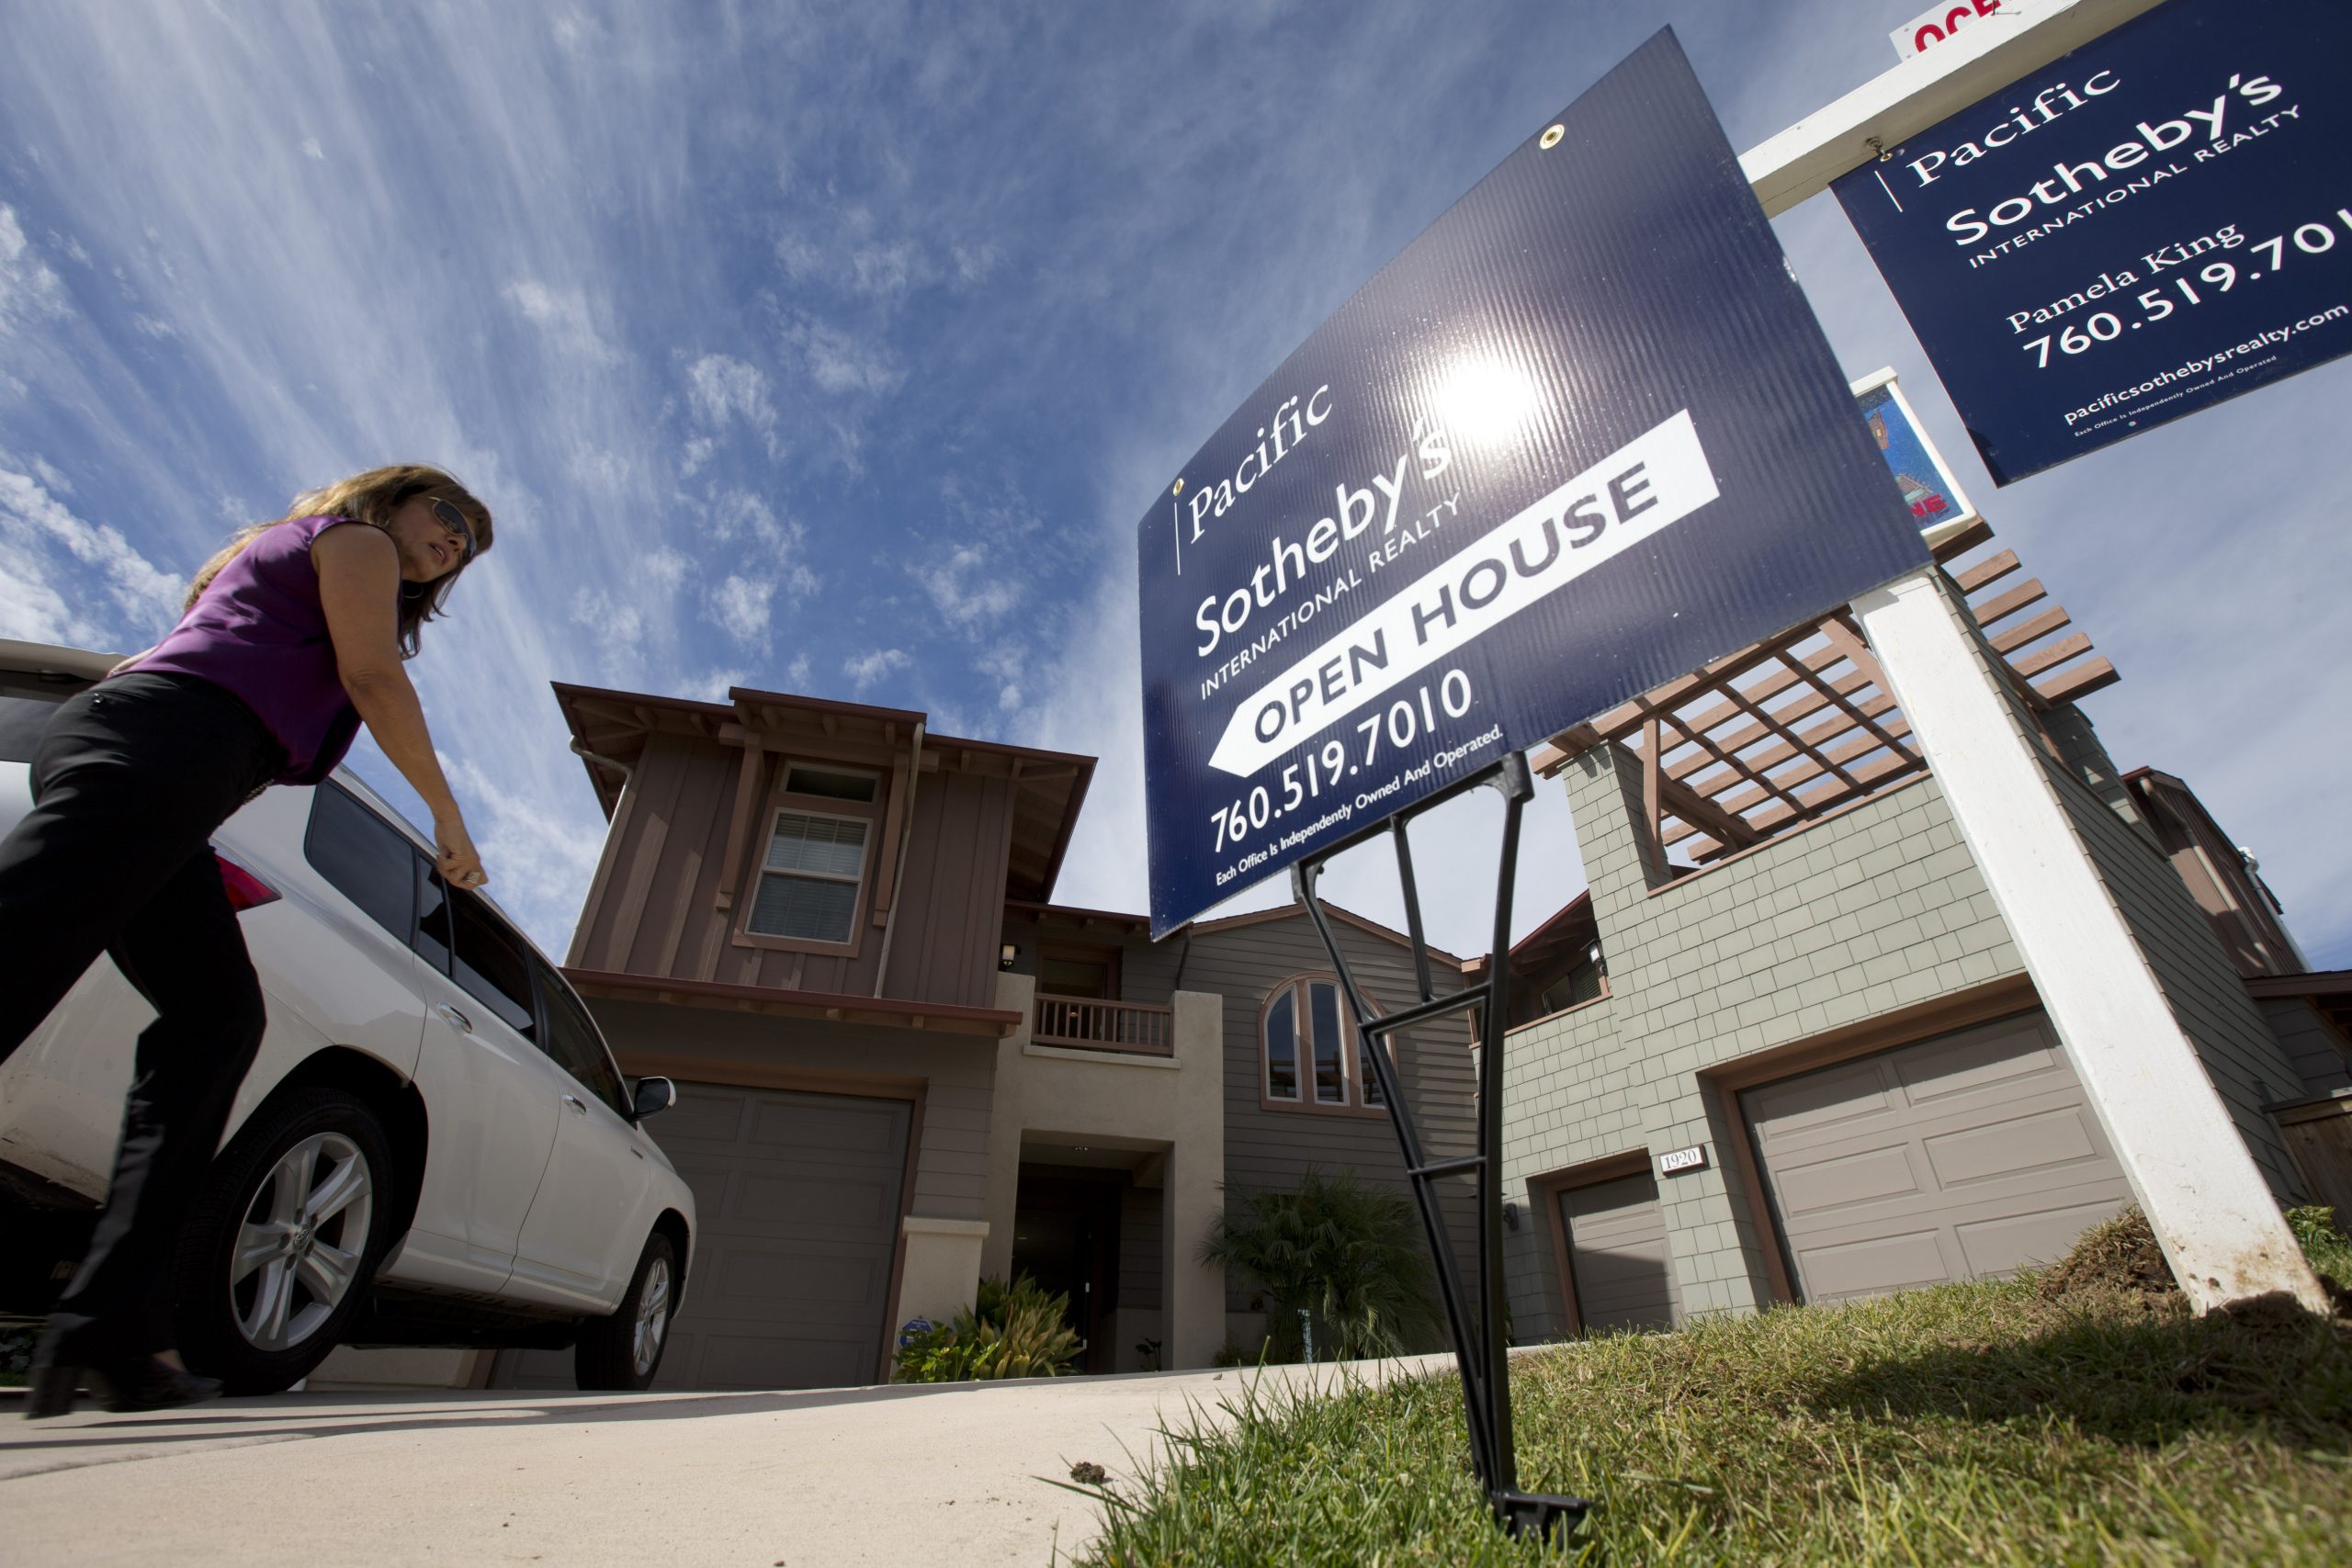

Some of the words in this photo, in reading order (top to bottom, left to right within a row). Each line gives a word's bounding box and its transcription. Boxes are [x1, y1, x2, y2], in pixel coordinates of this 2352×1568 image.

[1905, 70, 2120, 188] Pacific
[1946, 73, 2282, 246] Sotheby's
[1969, 164, 2188, 269] INTERNATIONAL
[2193, 105, 2300, 163] REALTY
[2006, 271, 2140, 334] Pamela
[2140, 223, 2245, 275] King
[2064, 305, 2349, 426] pacificsothebysrealty.com
[2074, 427, 2093, 437] Each
[2094, 417, 2118, 429] Office
[2128, 391, 2184, 416] Independently
[2185, 378, 2215, 393] Owned
[2217, 371, 2234, 382] And
[2235, 355, 2277, 374] Operated
[1188, 383, 1333, 545] Pacific
[1195, 416, 1453, 657] Sotheby's
[1201, 575, 1363, 701] INTERNATIONAL
[1369, 491, 1464, 573] REALTY
[1254, 628, 1388, 743] OPEN
[1410, 460, 1658, 646] HOUSE
[1210, 668, 1472, 852] 760.519.7010
[1216, 865, 1237, 886] Each
[1238, 851, 1268, 873] Office
[1269, 844, 1279, 856] Is
[1280, 804, 1352, 851] Independently
[1354, 775, 1401, 809] Owned
[1404, 760, 1431, 786] And
[1432, 723, 1504, 769] Operated.
[1664, 1149, 1697, 1169] 1920
